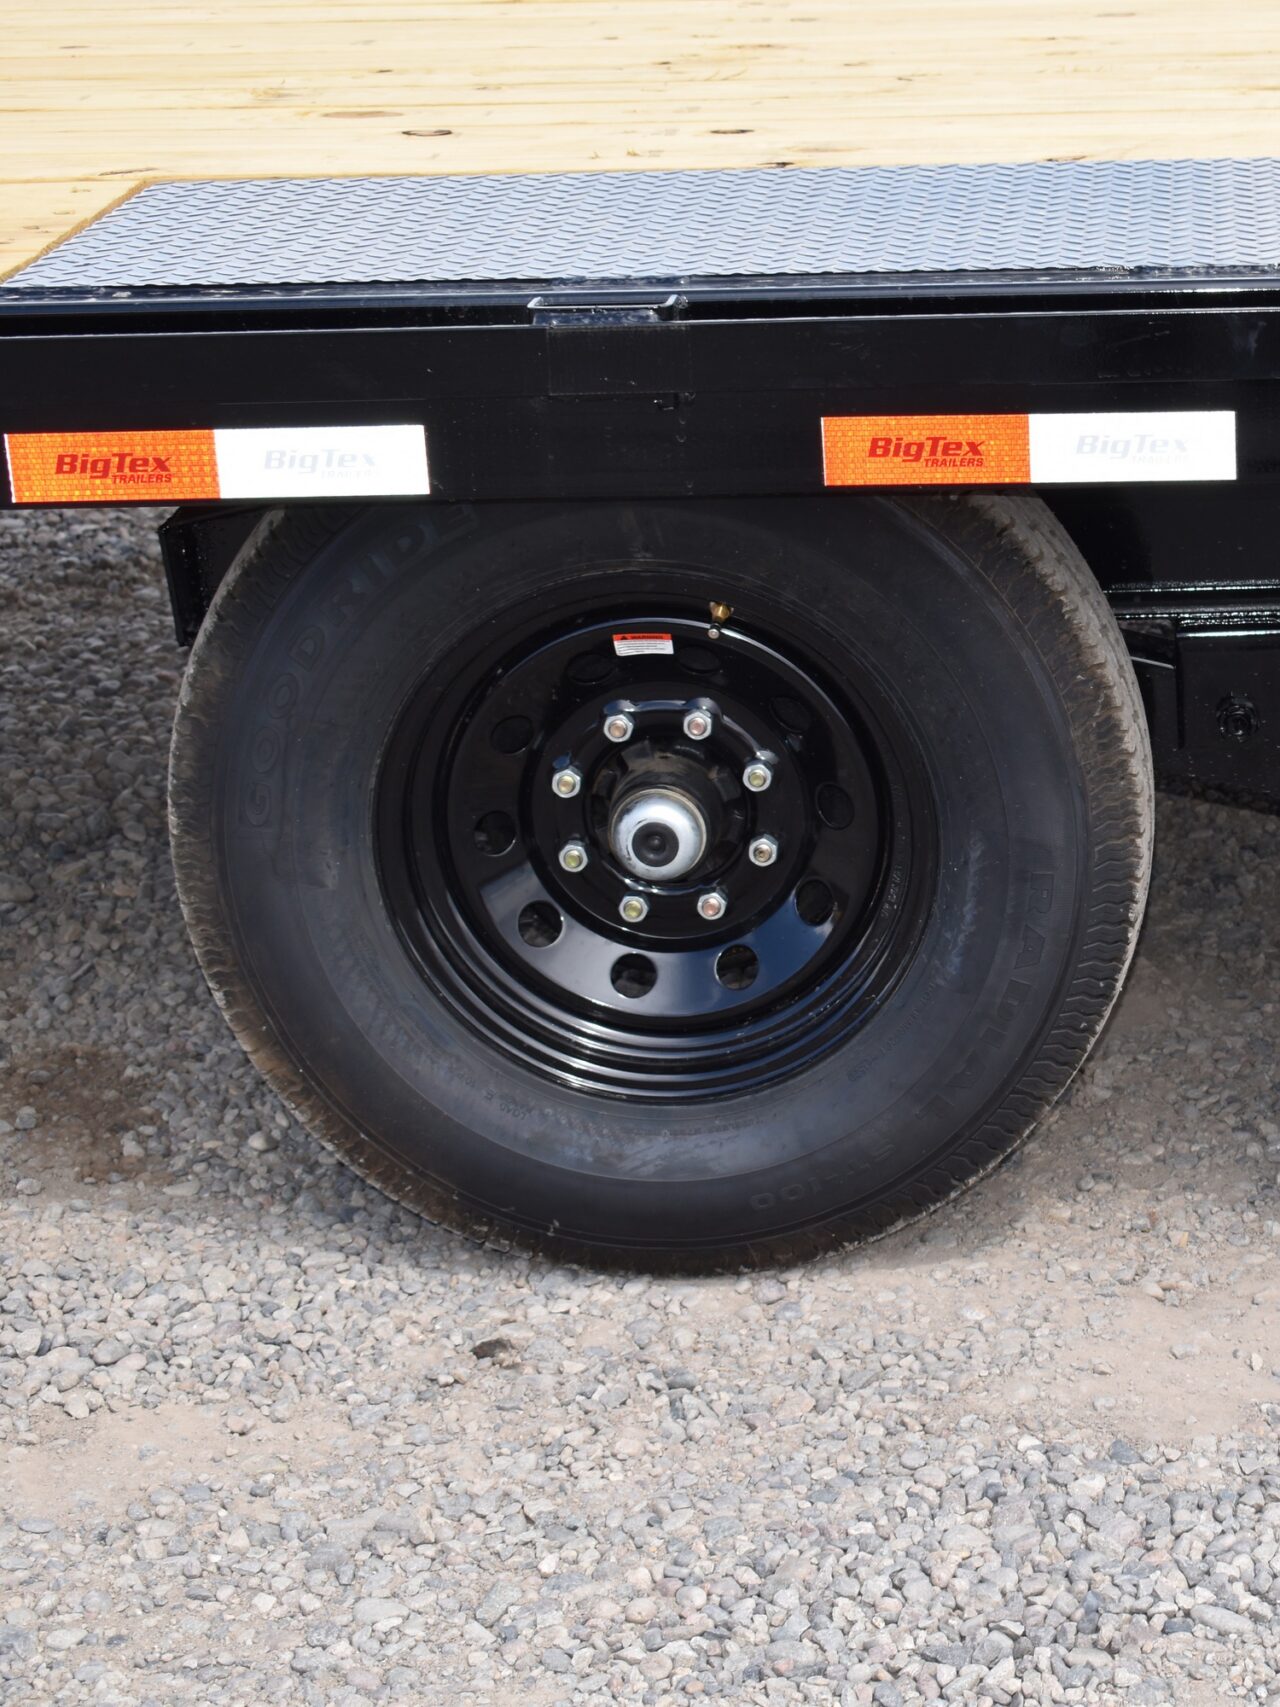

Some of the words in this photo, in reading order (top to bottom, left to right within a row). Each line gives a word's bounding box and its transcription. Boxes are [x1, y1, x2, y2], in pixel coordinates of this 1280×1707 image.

[868, 436, 985, 462] BigTex
[1076, 433, 1189, 460] BigTex
[55, 452, 172, 480] BigTex
[263, 448, 377, 475] BigTex
[923, 456, 984, 468] TRAILERS
[111, 472, 172, 485] TRAILERS
[914, 871, 1058, 1121] RADIAL
